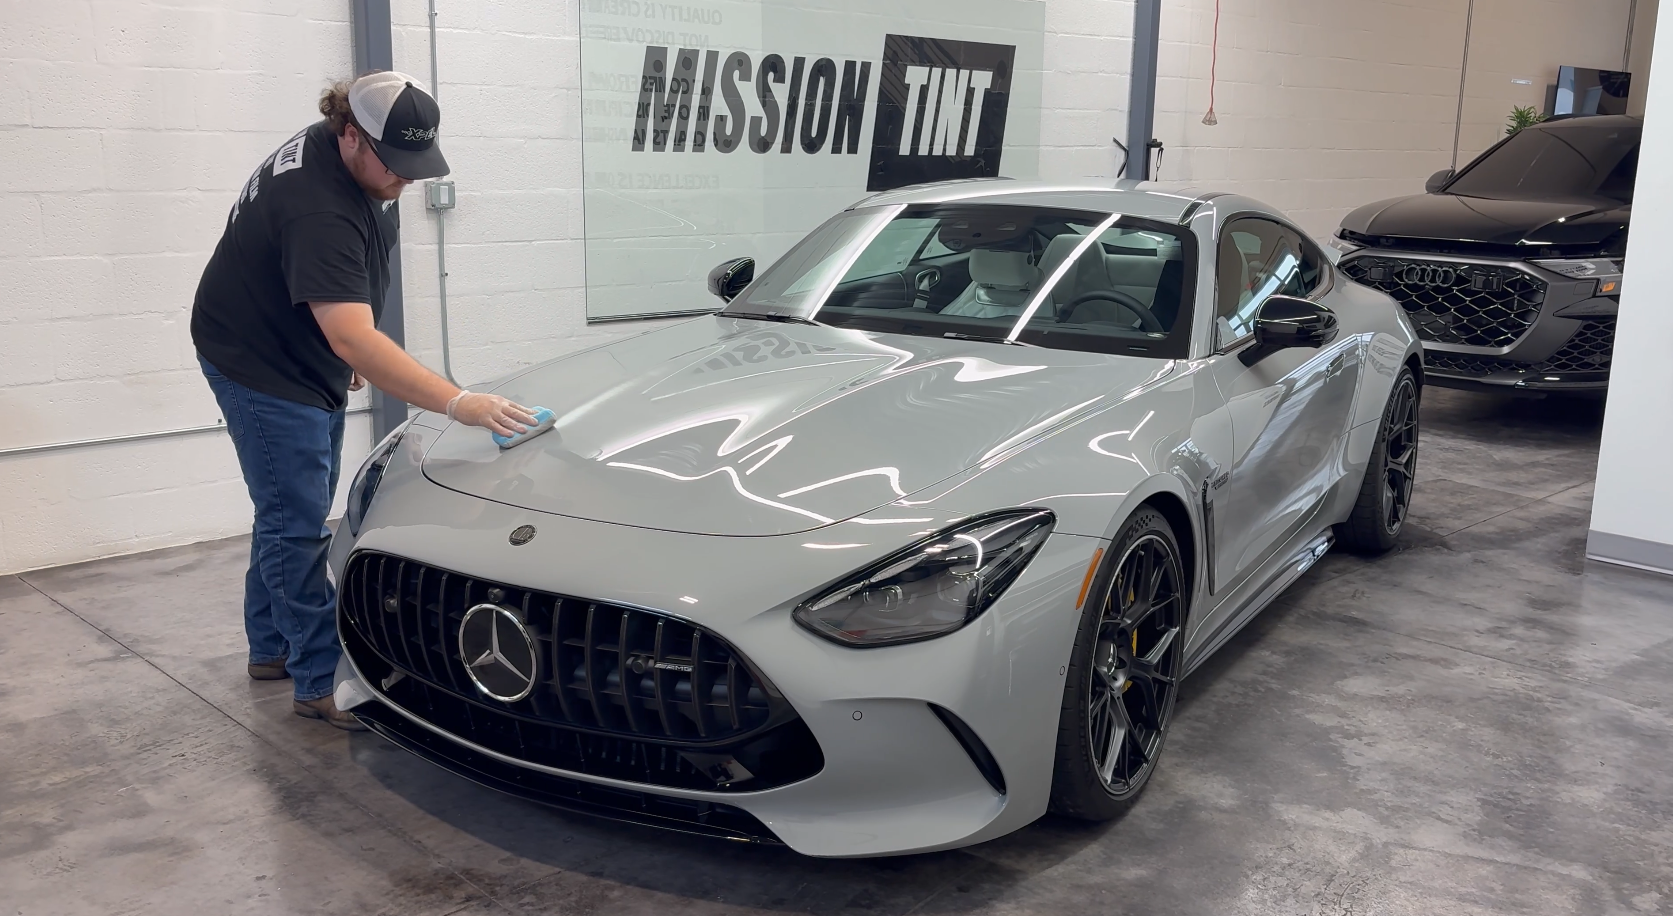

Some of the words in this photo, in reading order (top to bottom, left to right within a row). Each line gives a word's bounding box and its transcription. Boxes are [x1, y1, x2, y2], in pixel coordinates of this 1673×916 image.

[631, 45, 872, 155] MISSION
[898, 65, 993, 156] TINT
[280, 142, 299, 166] TINT
